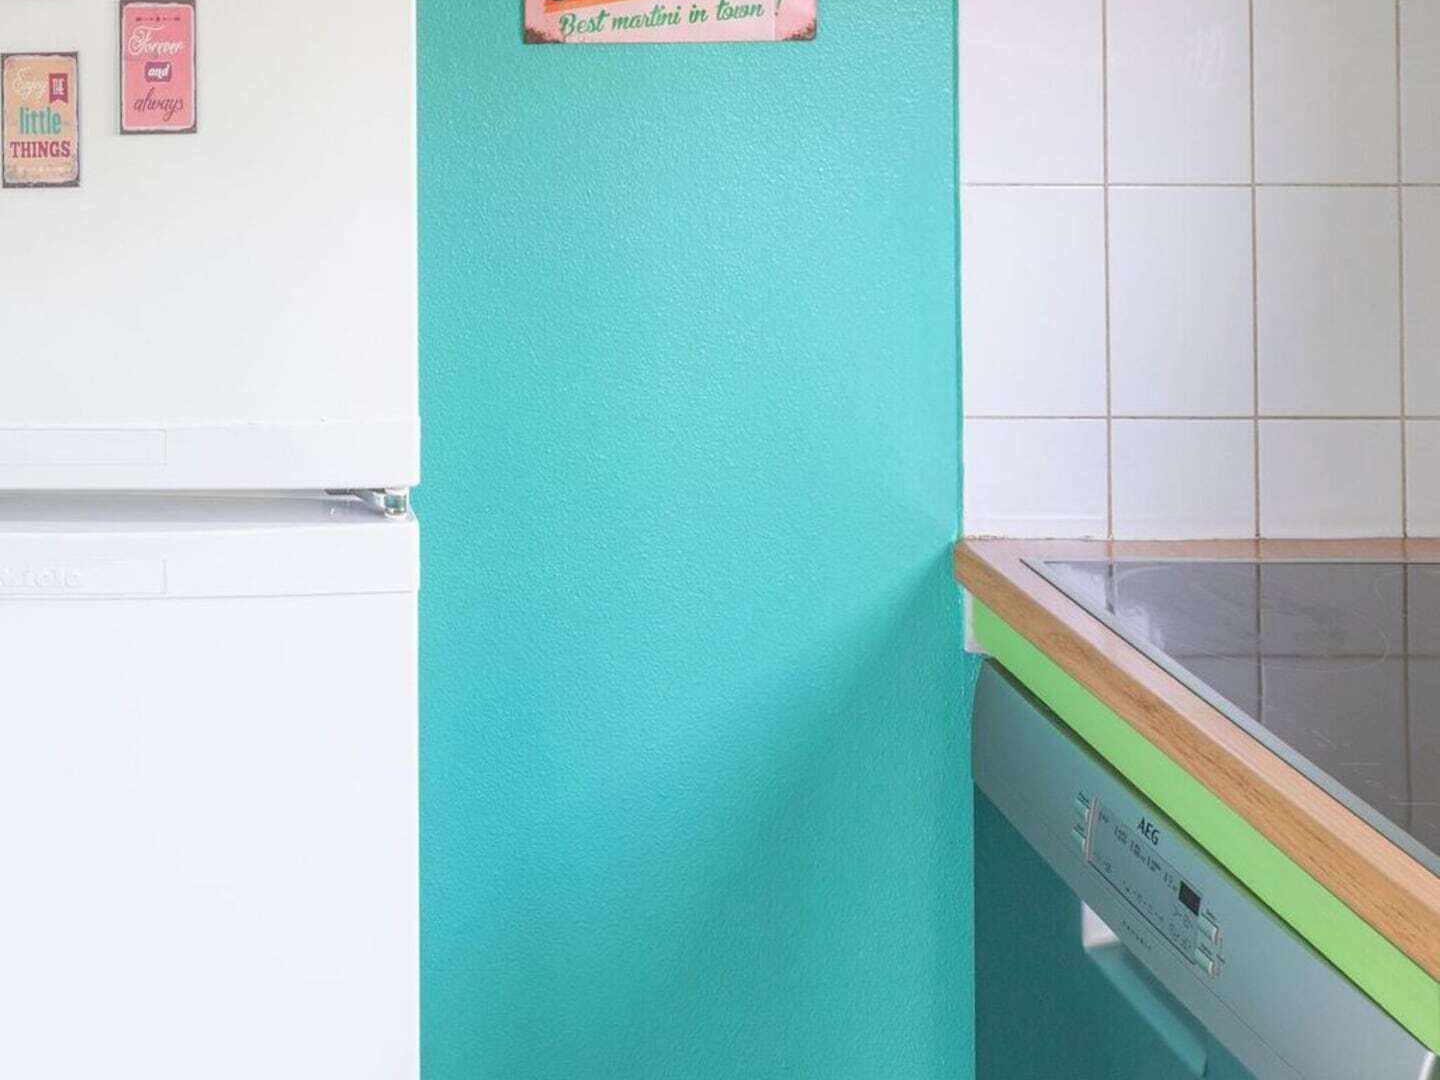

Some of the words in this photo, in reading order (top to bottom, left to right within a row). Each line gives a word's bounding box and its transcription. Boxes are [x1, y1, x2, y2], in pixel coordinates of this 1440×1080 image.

[559, 10, 608, 37] Best
[611, 4, 682, 29] martini
[689, 5, 709, 22] in
[128, 23, 183, 56] Forever
[147, 63, 170, 80] and
[133, 87, 184, 122] always
[20, 106, 62, 135] little
[10, 140, 71, 158] THINGS
[1136, 816, 1160, 846] AEG
